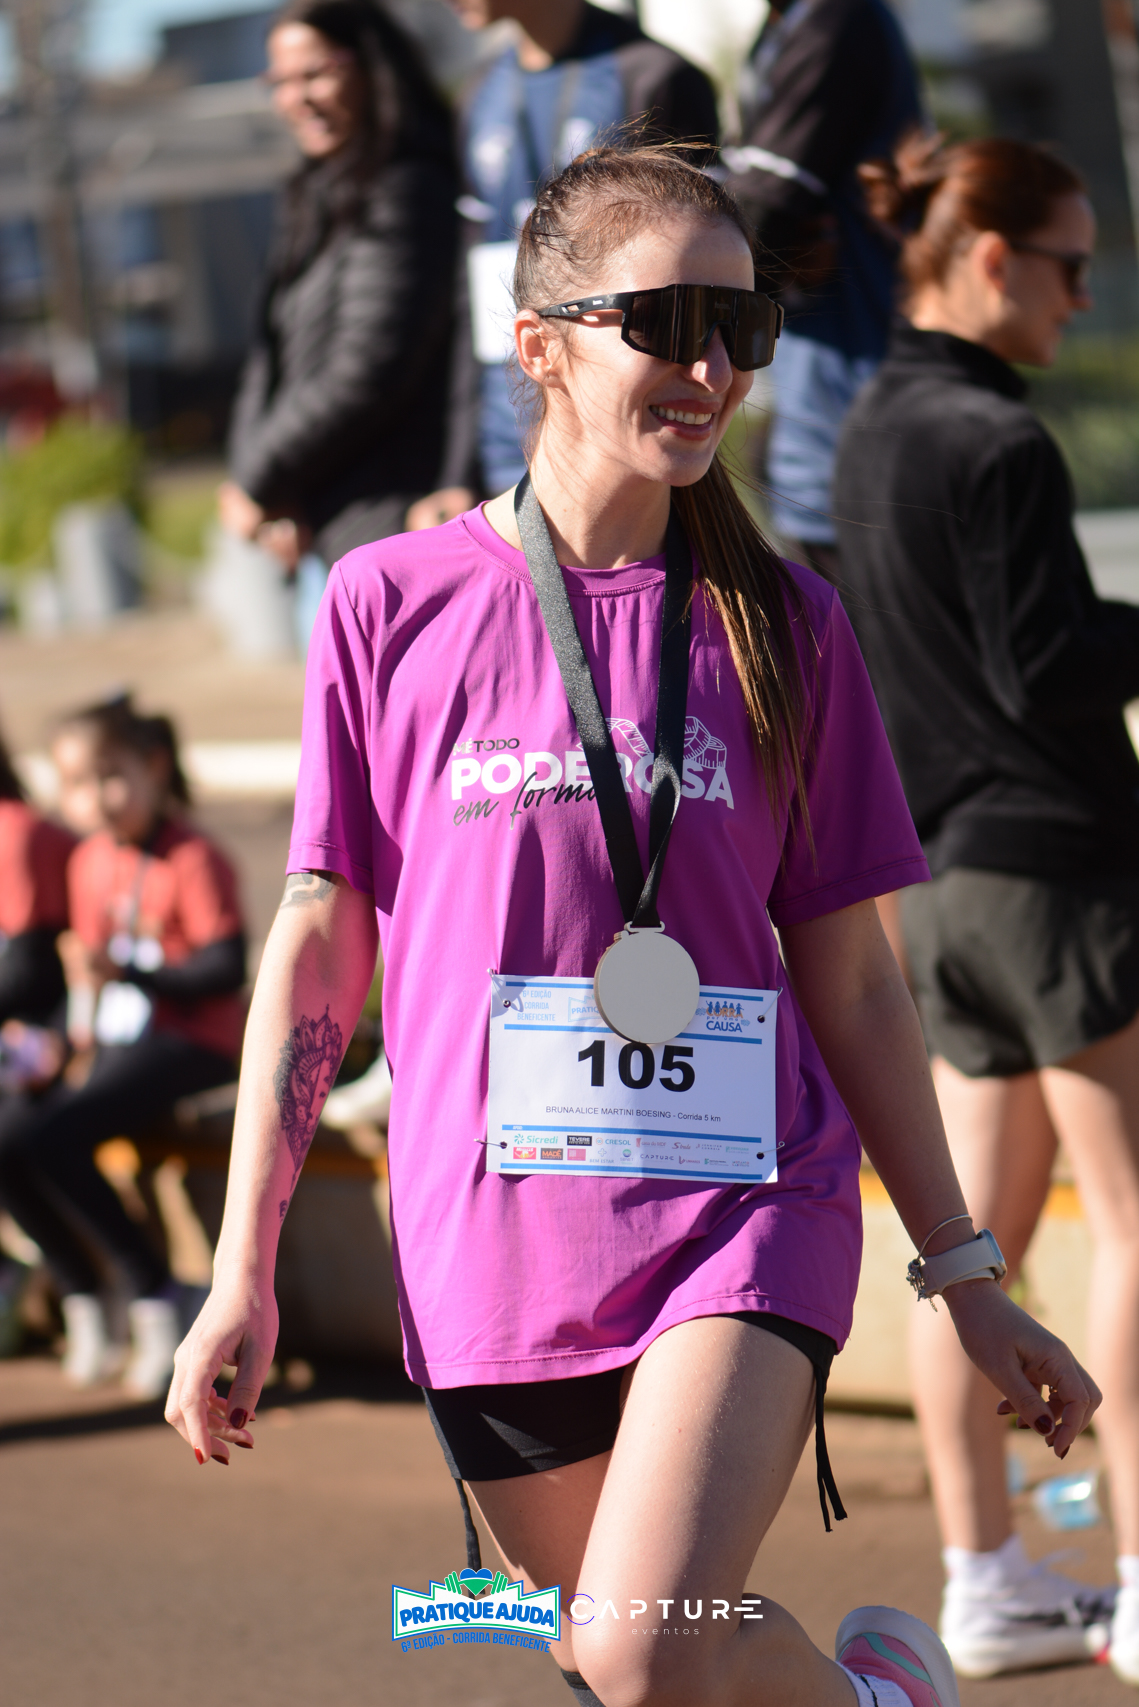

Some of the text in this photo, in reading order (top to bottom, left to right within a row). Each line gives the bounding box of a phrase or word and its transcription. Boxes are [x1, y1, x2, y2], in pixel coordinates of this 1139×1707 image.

[453, 737, 520, 756] MÉTODO
[453, 798, 499, 826] em
[530, 990, 552, 999] EDIÇÃO
[524, 1002, 550, 1010] CORRIDA
[517, 1012, 556, 1022] BENEFICENTE
[706, 1020, 743, 1033] CAUSA
[578, 1039, 695, 1093] 105
[546, 1106, 574, 1114] BRUNA
[575, 1107, 599, 1115] ALICE
[600, 1107, 634, 1116] MARTINI
[636, 1109, 672, 1119] BOESING
[677, 1112, 703, 1121] Corrida
[710, 1114, 722, 1122] km
[526, 1135, 558, 1144] Sicredi
[605, 1138, 631, 1146] CRESOL
[640, 1153, 675, 1161] CAPTURE
